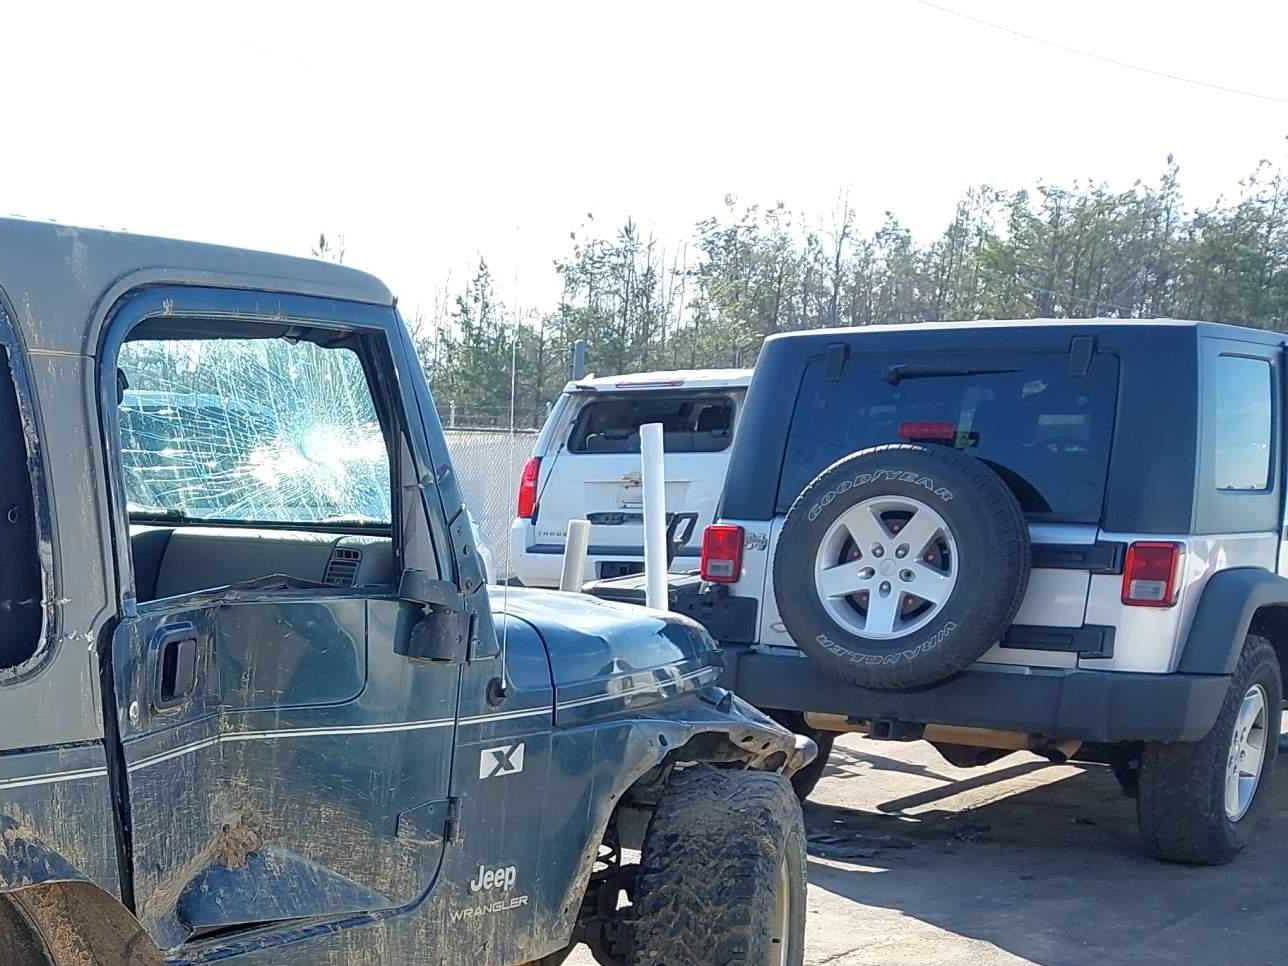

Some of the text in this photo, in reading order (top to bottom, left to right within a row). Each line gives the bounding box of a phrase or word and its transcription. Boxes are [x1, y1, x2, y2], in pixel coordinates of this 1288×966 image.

[808, 469, 954, 522] GOODYEAR
[815, 620, 958, 665] WRANGLER
[480, 743, 525, 779] X
[470, 864, 517, 892] Jeep
[450, 895, 529, 923] WRANGLER
